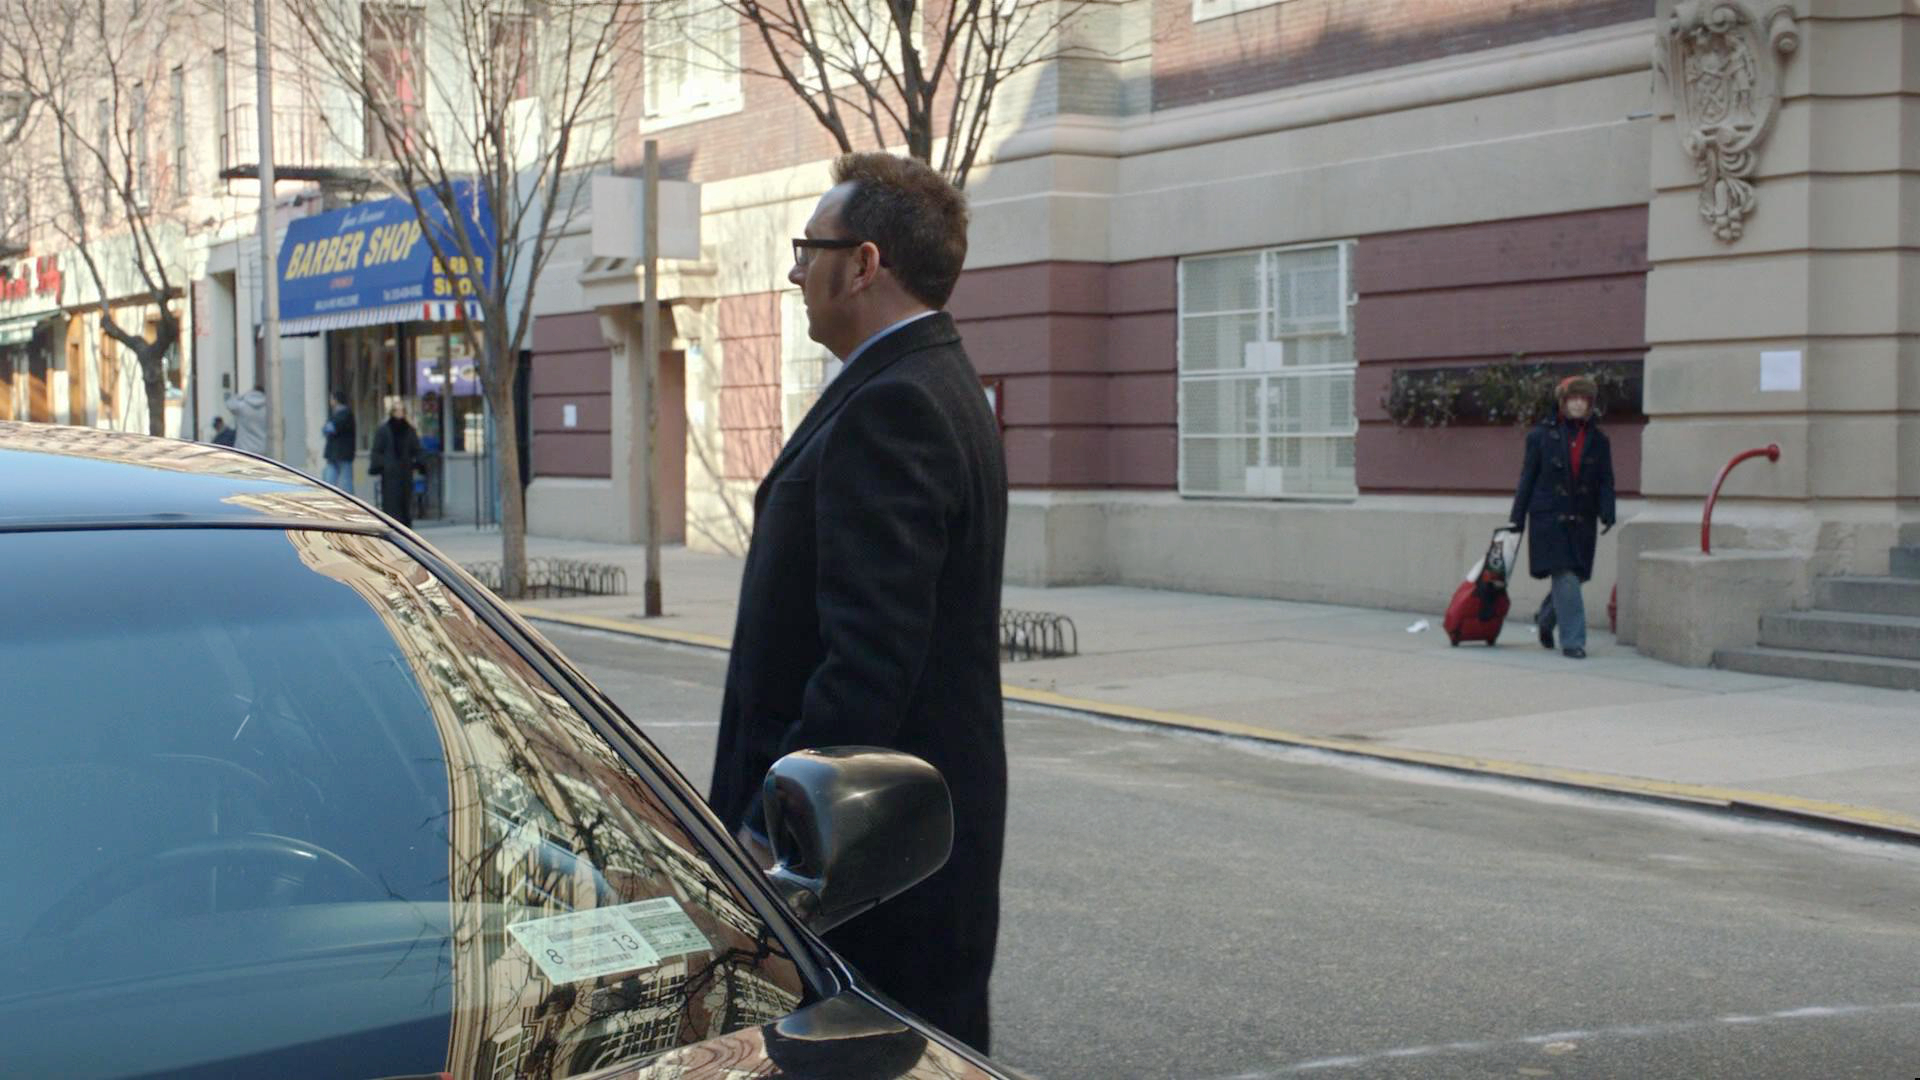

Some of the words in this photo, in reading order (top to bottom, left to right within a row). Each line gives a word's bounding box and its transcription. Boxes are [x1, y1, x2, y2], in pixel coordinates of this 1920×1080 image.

[284, 230, 366, 281] BARBER
[363, 219, 423, 269] SHOP
[432, 256, 484, 275] BRBR
[545, 948, 564, 965] 8
[611, 934, 640, 951] 13
